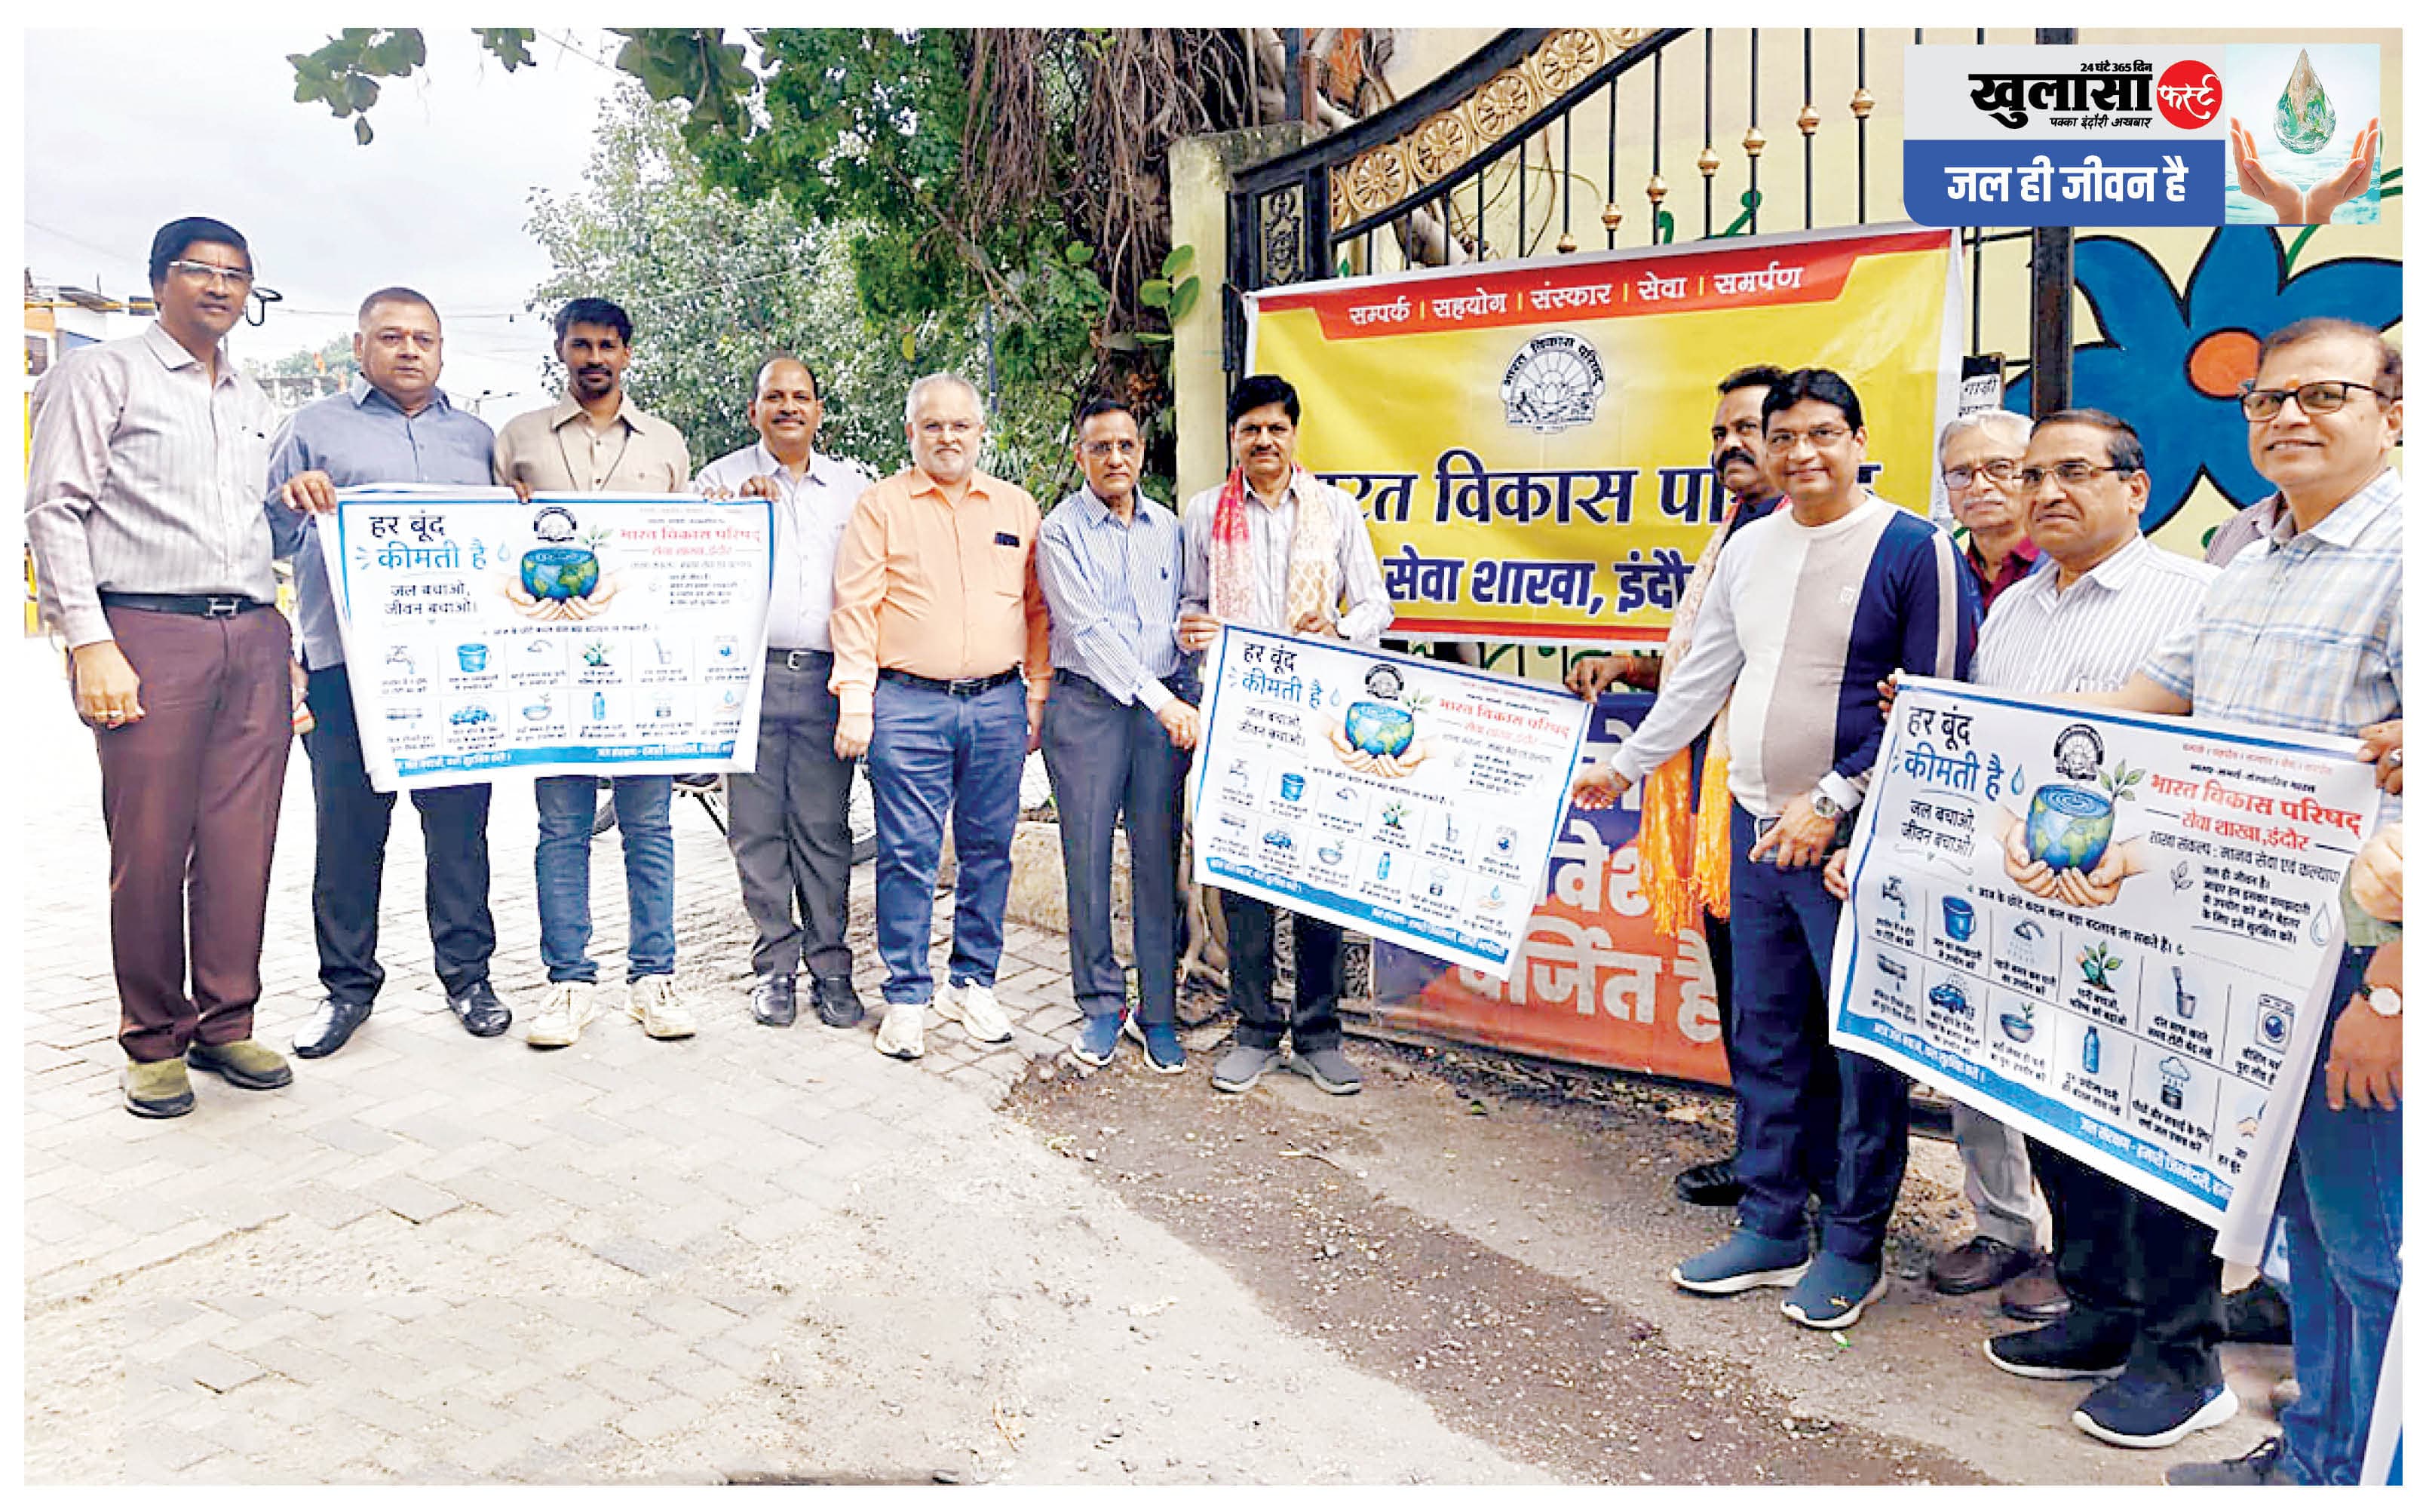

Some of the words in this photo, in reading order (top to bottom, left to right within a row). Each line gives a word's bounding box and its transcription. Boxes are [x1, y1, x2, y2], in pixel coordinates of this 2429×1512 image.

[1350, 296, 1411, 325] सम्पर्क
[1434, 288, 1507, 318] सहयोग
[1531, 283, 1612, 309] संस्कार
[1639, 272, 1688, 300] सेवा
[1714, 262, 1804, 294] समर्पण
[1315, 474, 1418, 522] रत
[1434, 449, 1635, 526] विकास
[369, 517, 399, 538] हर
[411, 511, 448, 543] बूंद
[378, 539, 459, 569] कीमती
[473, 539, 486, 569] है
[1383, 544, 1465, 601] सेवा
[1472, 560, 1605, 615] शाखा,
[1614, 548, 1695, 612] इंदौ
[1244, 643, 1265, 662] हर
[1243, 668, 1302, 702] कीमती
[1309, 679, 1323, 710] है
[1907, 707, 1936, 737] हर
[1941, 706, 1974, 753] बूंद
[1905, 741, 1980, 792] कीमती
[1986, 753, 2004, 802] है
[1911, 799, 1932, 819] जल
[2151, 774, 2200, 799] भारत
[2203, 779, 2274, 815] विकास
[2280, 796, 2363, 840] परिषद्
[2182, 809, 2212, 832] सेवा
